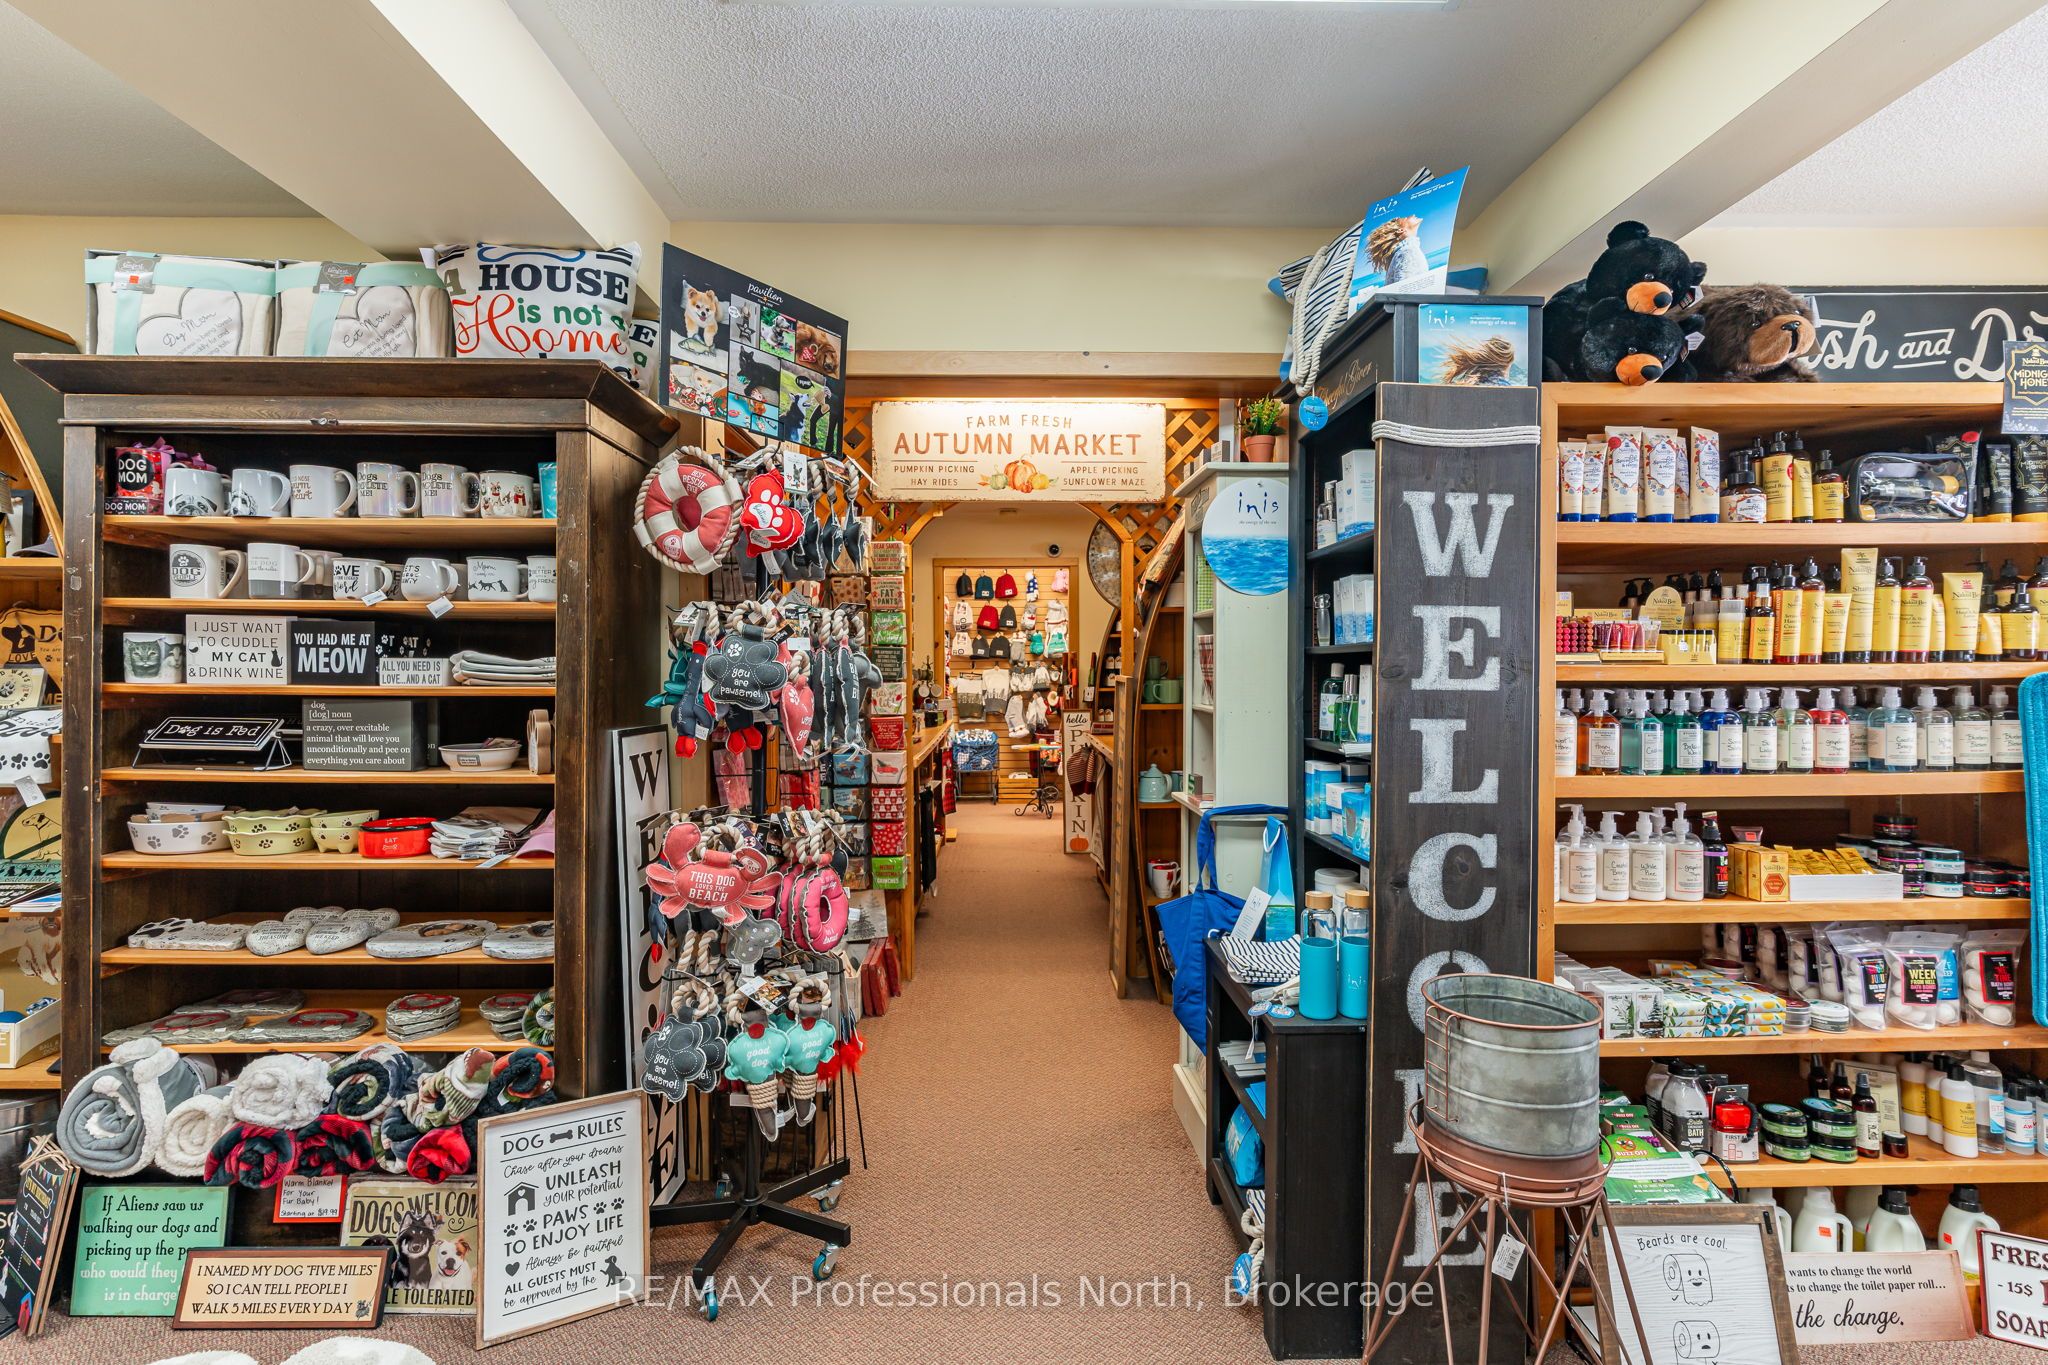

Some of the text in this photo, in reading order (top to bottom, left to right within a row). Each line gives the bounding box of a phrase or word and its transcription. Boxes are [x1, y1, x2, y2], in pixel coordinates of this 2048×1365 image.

[1373, 198, 1398, 213] inis
[477, 263, 630, 305] HOUSE
[747, 283, 784, 304] pavilion
[517, 297, 542, 323] is
[553, 305, 602, 326] not
[1427, 308, 1456, 328] inis
[1898, 328, 1956, 360] and
[966, 414, 1072, 429] FARM FRESH
[893, 431, 1142, 456] AUTUMN MARKET
[118, 458, 147, 470] DOG
[893, 465, 975, 473] PUMPKIN PICKING
[1070, 466, 1139, 474] APPLE PICKING
[118, 471, 147, 484] MOM
[690, 469, 706, 479] BEST
[682, 475, 708, 490] RESCUE
[910, 478, 958, 486] HAY RIDES
[1063, 478, 1117, 486] SUNFLOWER
[105, 502, 123, 511] DOG
[1238, 491, 1279, 519] inis
[880, 588, 895, 599] FAT
[878, 598, 899, 606] PANTS
[203, 622, 283, 634] JUST WANT
[198, 636, 279, 648] TO CUDDLE
[294, 633, 313, 645] YOU
[317, 633, 338, 645] HAD
[341, 633, 356, 645] ME
[359, 633, 371, 646] AT
[212, 652, 267, 663] MY CAT
[297, 647, 368, 674] MEOW
[199, 667, 284, 679] DRINK WINE
[412, 661, 431, 672] NEED
[731, 667, 751, 678] you
[733, 679, 749, 687] are
[310, 701, 326, 710] dog
[331, 711, 352, 719] noun
[355, 723, 390, 732] excitable
[306, 734, 400, 745] animal that will love you
[368, 745, 384, 753] and
[349, 756, 405, 766] you care about
[690, 870, 736, 887] THIS DOG
[695, 881, 716, 891] LOVES
[688, 889, 729, 902] BEACH
[1909, 968, 1937, 981] WEEK
[747, 1045, 771, 1058] good
[653, 1053, 669, 1066] you
[751, 1058, 769, 1068] dog
[654, 1064, 667, 1075] are
[503, 1117, 624, 1155] DOG RULES
[1687, 1129, 1704, 1137] BATH
[503, 1145, 624, 1179] Chase after your dreams
[545, 1160, 621, 1190] UNLEASH
[577, 1176, 624, 1201] potential
[102, 1195, 204, 1216] If Aliens saw us
[407, 1191, 478, 1220] WELCOM
[543, 1204, 589, 1229] PAWS
[83, 1217, 219, 1238] walking our dogs and
[504, 1214, 624, 1257] TO ENJOY LIFE
[1637, 1232, 1728, 1251] Beards are cool.
[86, 1239, 174, 1260] picking up the
[583, 1235, 624, 1257] faithful
[1990, 1241, 2048, 1272] FRES
[80, 1262, 178, 1283] who would they
[204, 1265, 304, 1277] NAMED MY DOG
[1789, 1264, 1912, 1278] wants to change the world
[504, 1261, 597, 1295] ALL GUESTS MUST
[206, 1283, 341, 1295] SO CAN TELL PEOPLE
[1796, 1279, 1946, 1294] to change the toilet paper roll...
[104, 1288, 130, 1301] is in
[404, 1288, 475, 1306] TOLERATED
[503, 1280, 578, 1309] be approved by
[191, 1302, 353, 1314] WALK 5 MILES EVERY DAY
[1795, 1298, 1905, 1335] the change.
